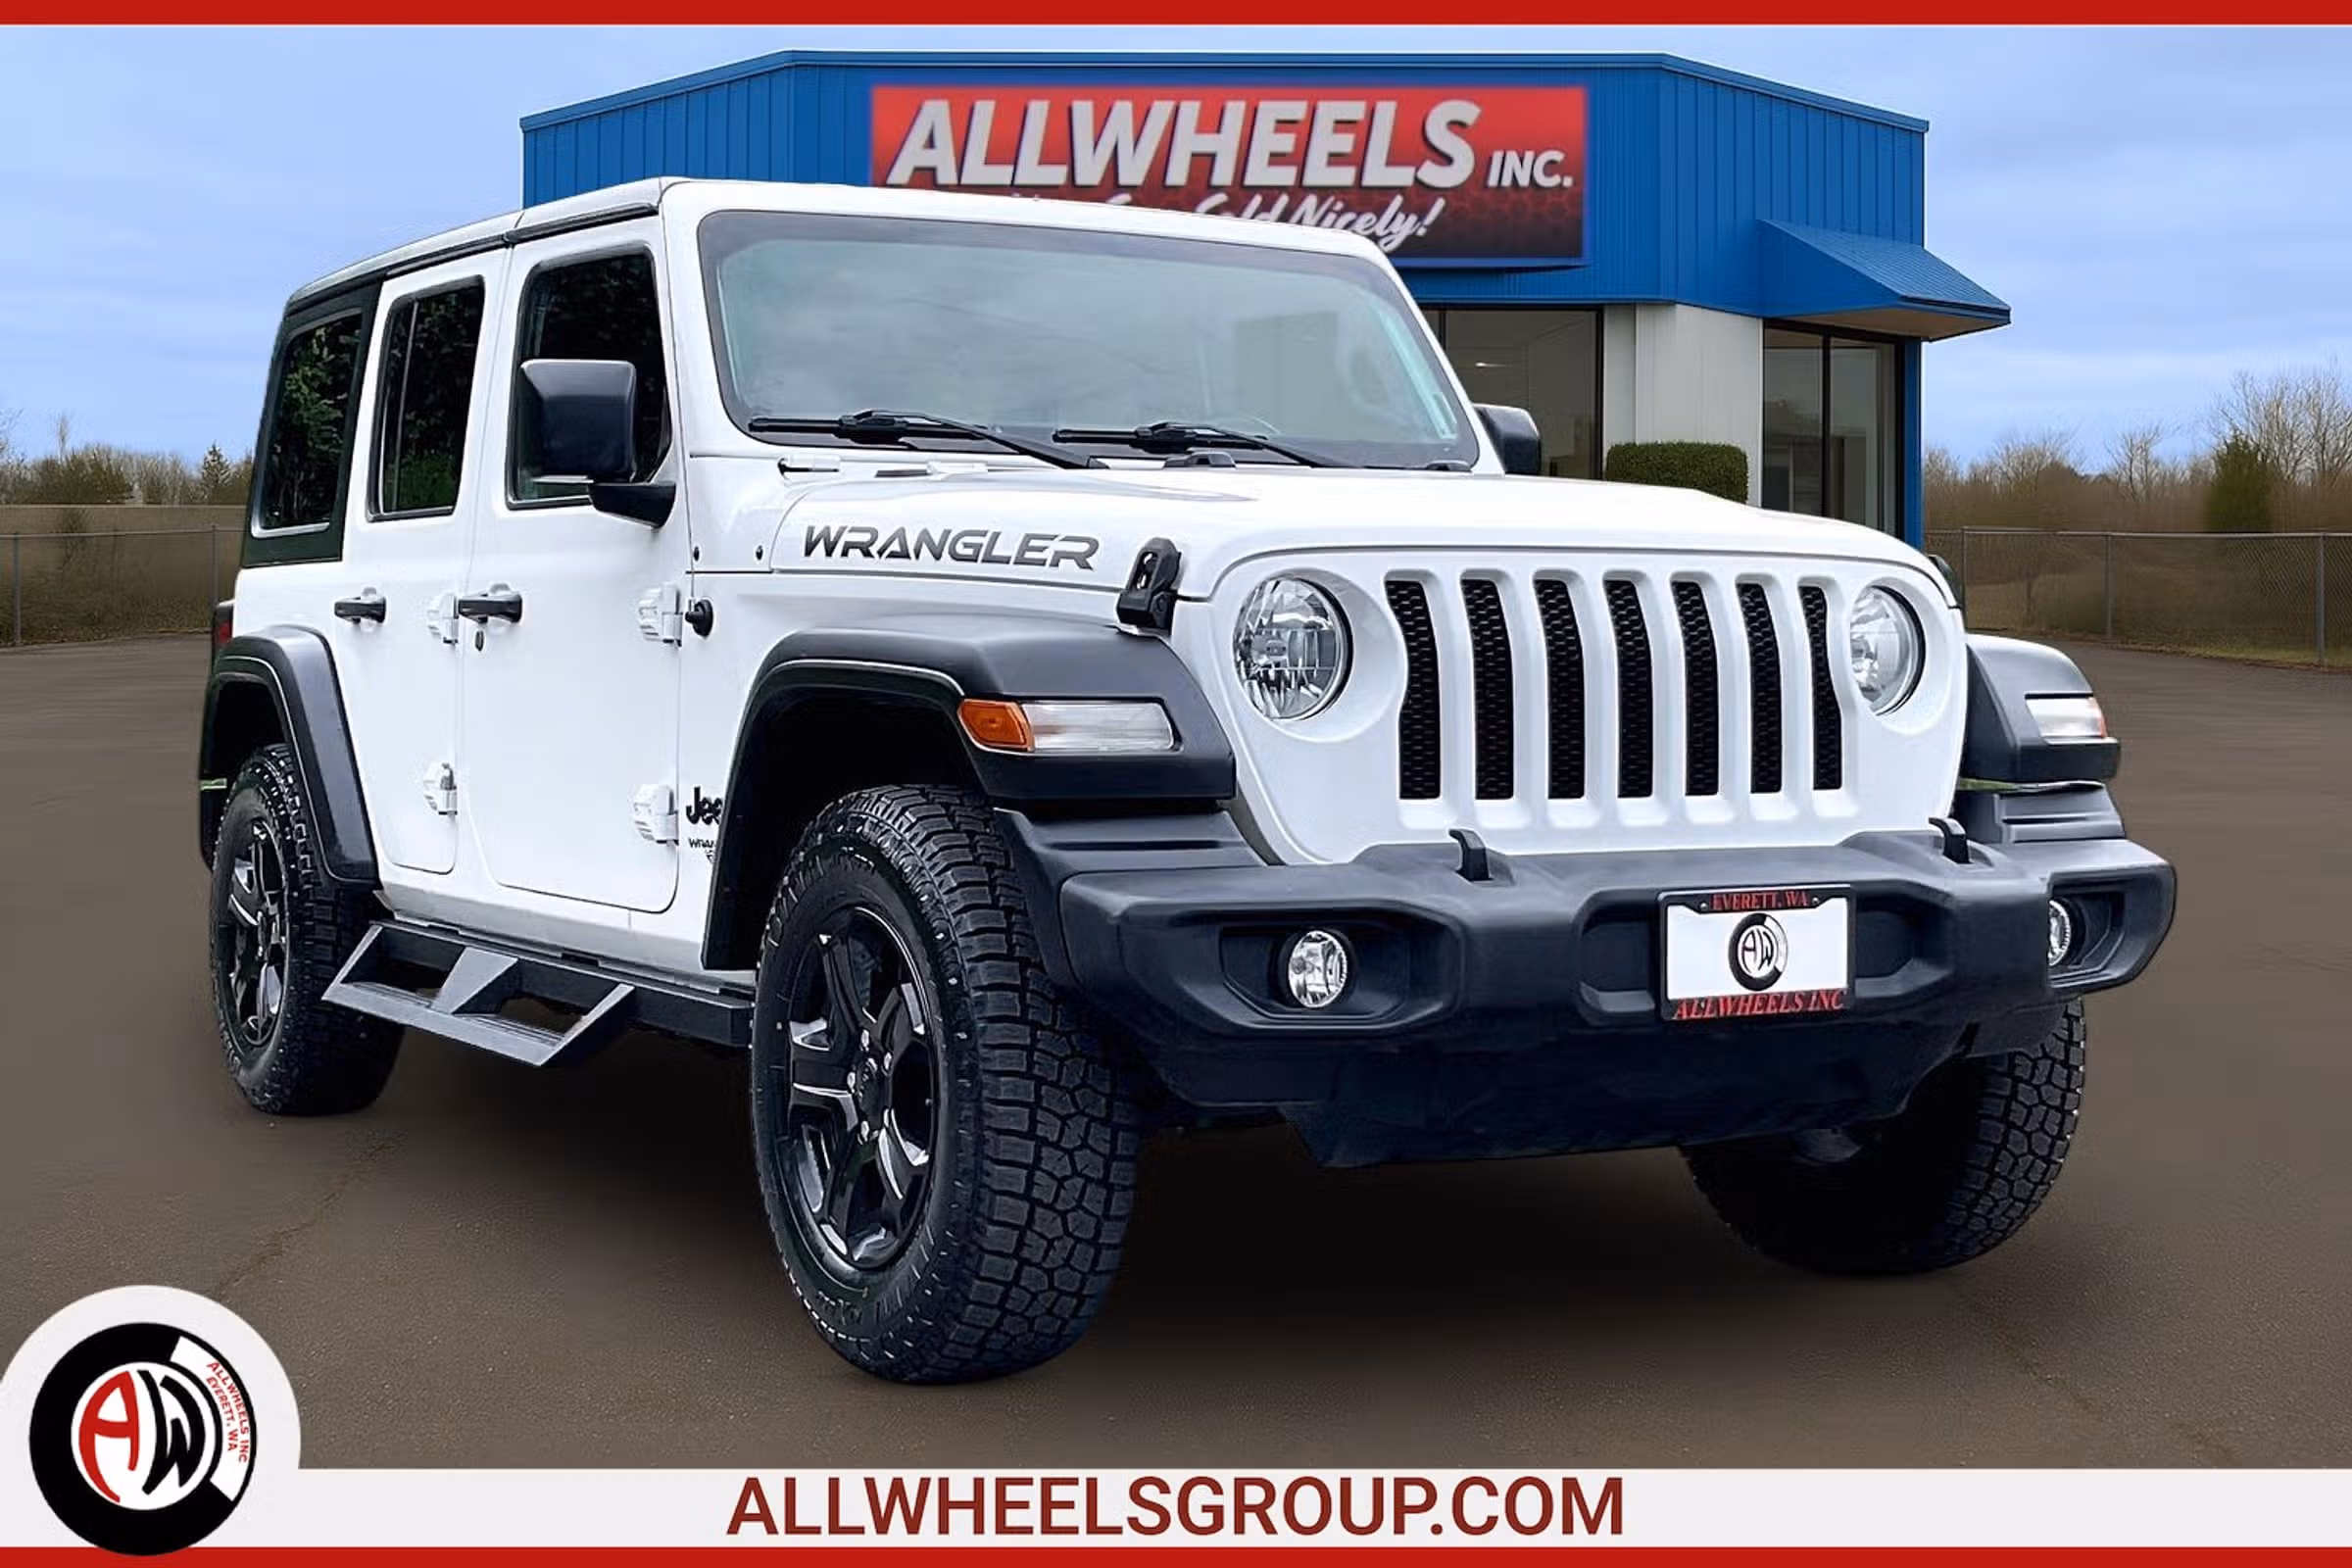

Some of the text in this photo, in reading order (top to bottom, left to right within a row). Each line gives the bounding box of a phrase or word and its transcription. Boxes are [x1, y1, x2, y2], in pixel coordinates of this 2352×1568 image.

[886, 99, 1574, 189] ALLWHEELS INC.
[1290, 193, 1446, 254] Nicely!
[804, 524, 1100, 570] WRANGLER
[685, 785, 723, 825] Jee
[1786, 890, 1809, 908] WA
[1672, 988, 1847, 1020] ALLWHEELS INC
